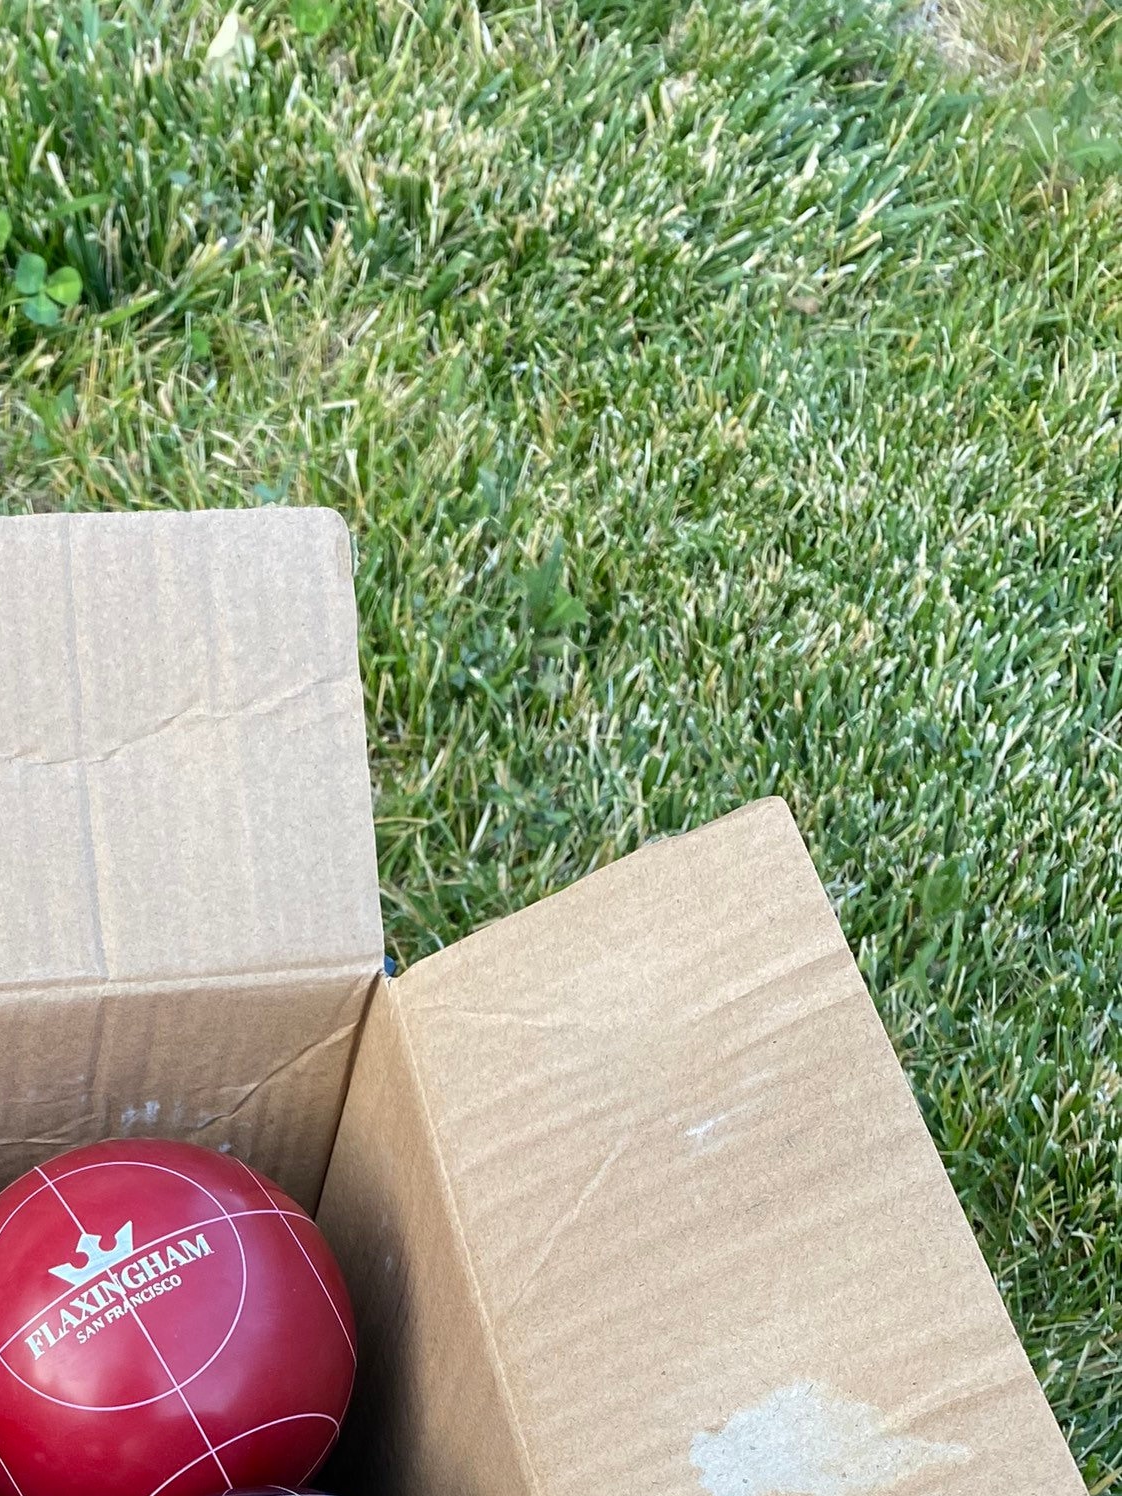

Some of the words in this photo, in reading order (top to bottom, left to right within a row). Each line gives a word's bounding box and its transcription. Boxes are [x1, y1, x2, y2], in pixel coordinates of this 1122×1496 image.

[24, 1233, 216, 1361] FLAXINGHAM
[76, 1318, 106, 1345] SAN
[104, 1274, 182, 1324] FRANCISCO
